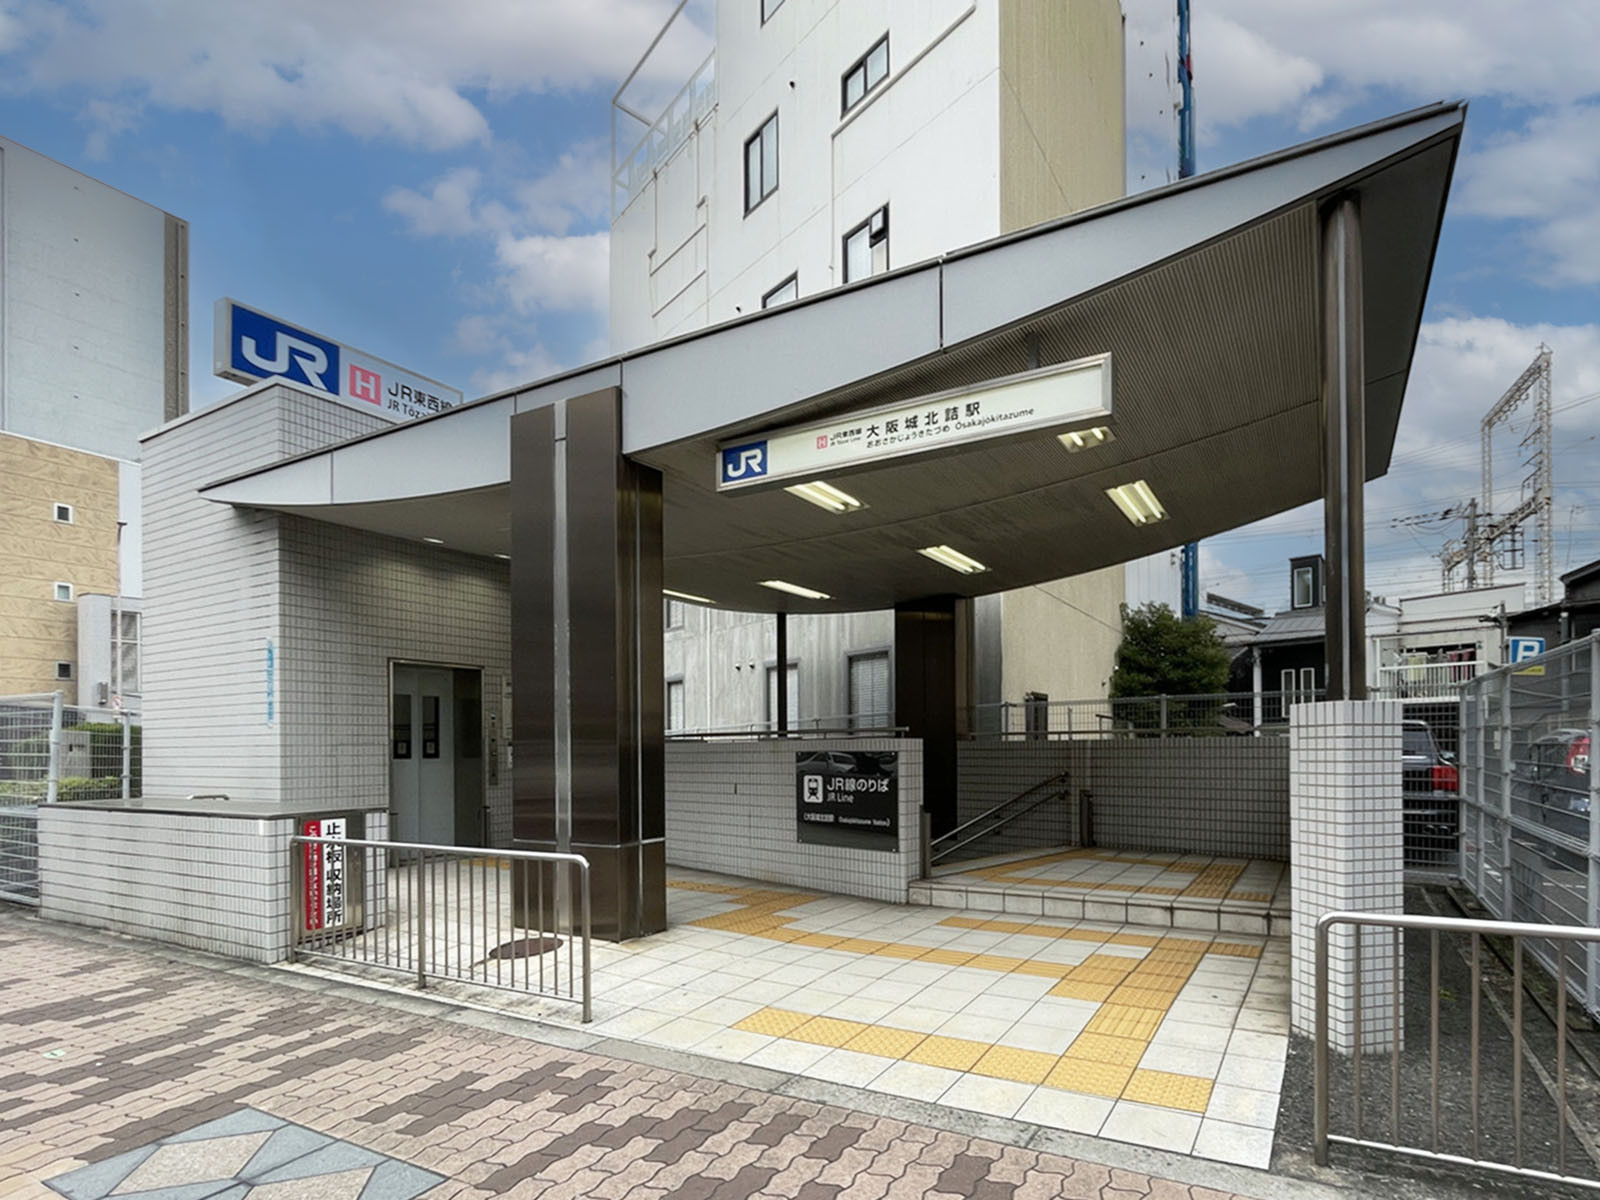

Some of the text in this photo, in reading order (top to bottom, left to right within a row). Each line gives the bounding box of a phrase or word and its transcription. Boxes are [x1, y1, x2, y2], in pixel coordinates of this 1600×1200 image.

[241, 331, 328, 392] JR
[354, 368, 378, 400] H
[388, 399, 400, 412] JR
[867, 401, 980, 438] 大阪城北詰駅
[728, 449, 762, 477] JR
[1517, 641, 1539, 663] P
[826, 777, 890, 792] JR線のりば
